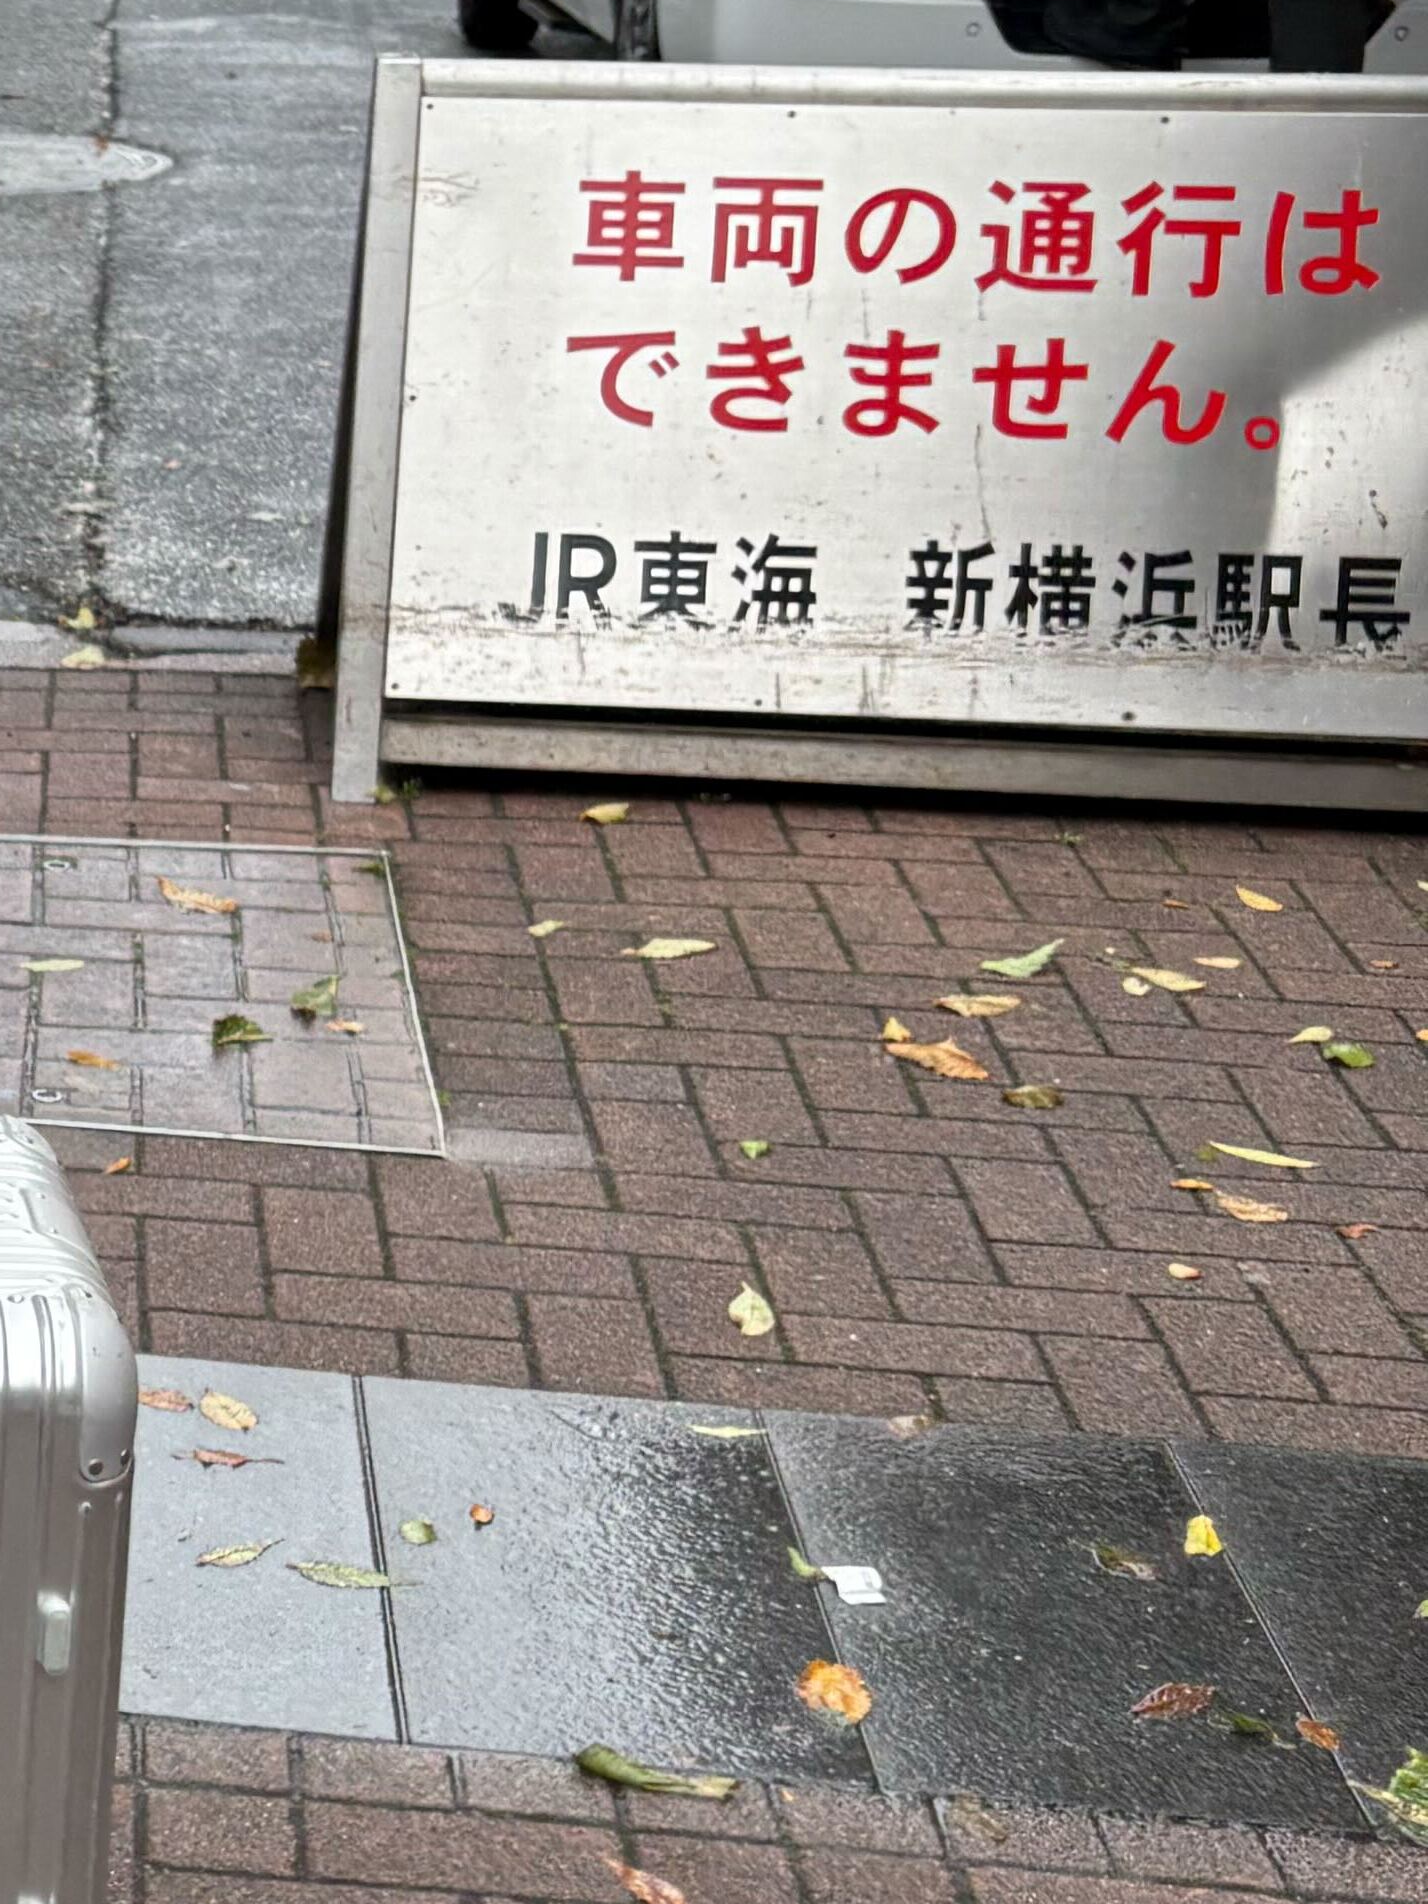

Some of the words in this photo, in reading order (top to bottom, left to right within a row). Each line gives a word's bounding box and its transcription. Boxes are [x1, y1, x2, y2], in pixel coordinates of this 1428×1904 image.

[571, 168, 1382, 299] 車両の通行は
[565, 325, 1280, 451] できません。
[904, 540, 1411, 652] 新横浜駅長
